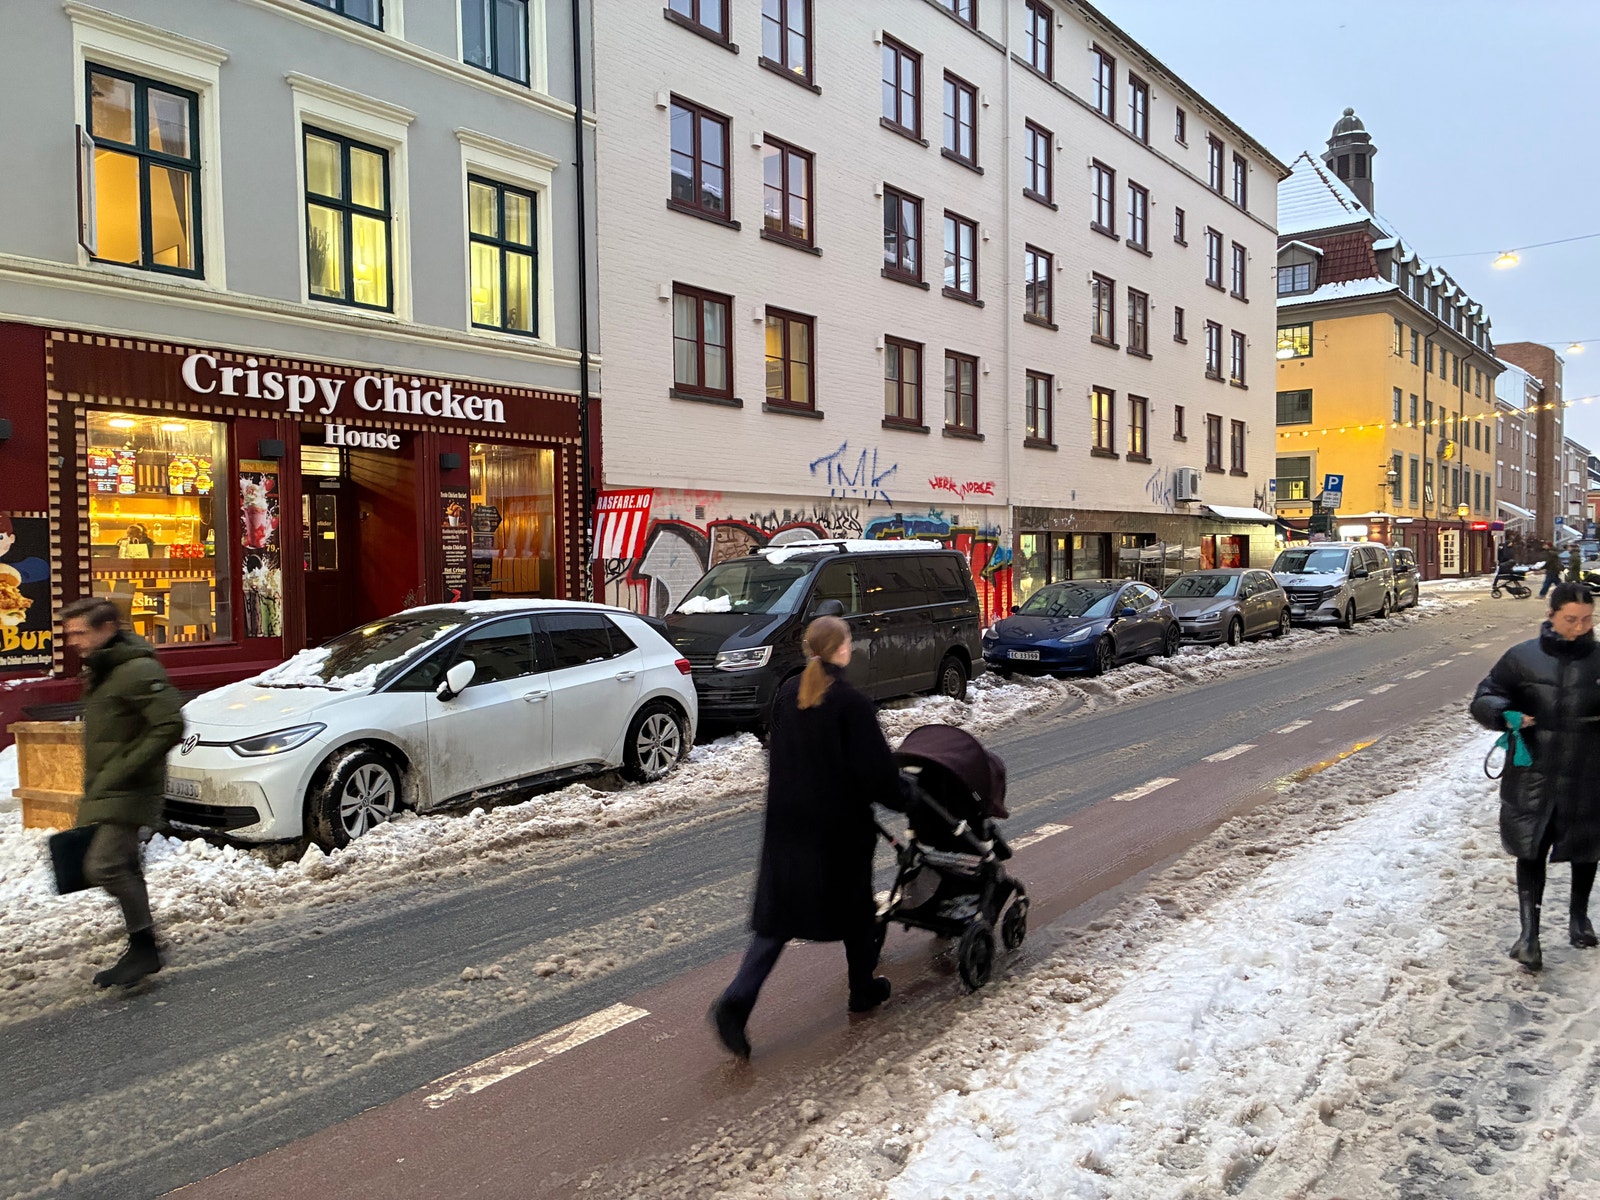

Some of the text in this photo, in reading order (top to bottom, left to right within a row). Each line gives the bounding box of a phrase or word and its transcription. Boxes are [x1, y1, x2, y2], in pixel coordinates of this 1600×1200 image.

[181, 353, 506, 423] Crispy Chicken
[323, 423, 401, 450] House
[809, 439, 898, 509] TMK
[1327, 476, 1339, 490] P
[596, 494, 651, 510] RASFARE.NO
